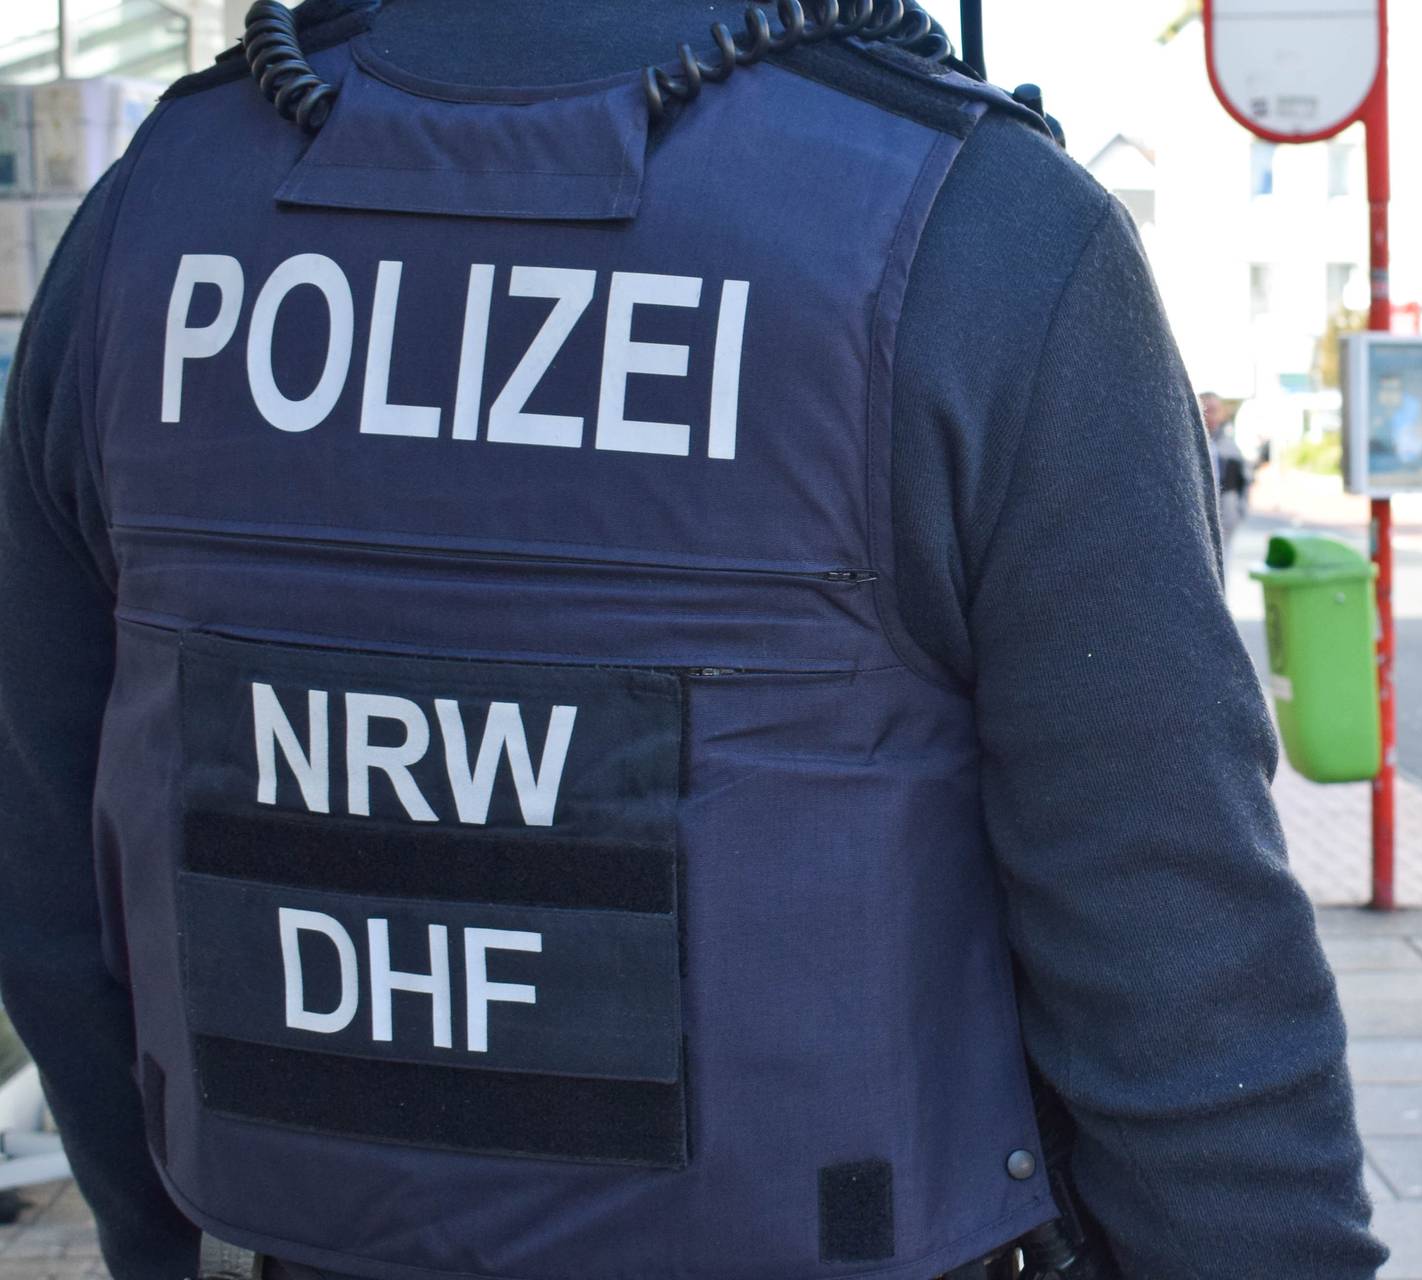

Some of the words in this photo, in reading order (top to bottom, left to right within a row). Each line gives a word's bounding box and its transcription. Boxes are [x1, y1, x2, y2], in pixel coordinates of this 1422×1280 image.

[161, 253, 750, 460] POLIZEI
[252, 682, 578, 826] NRW
[278, 907, 542, 1053] DHF
